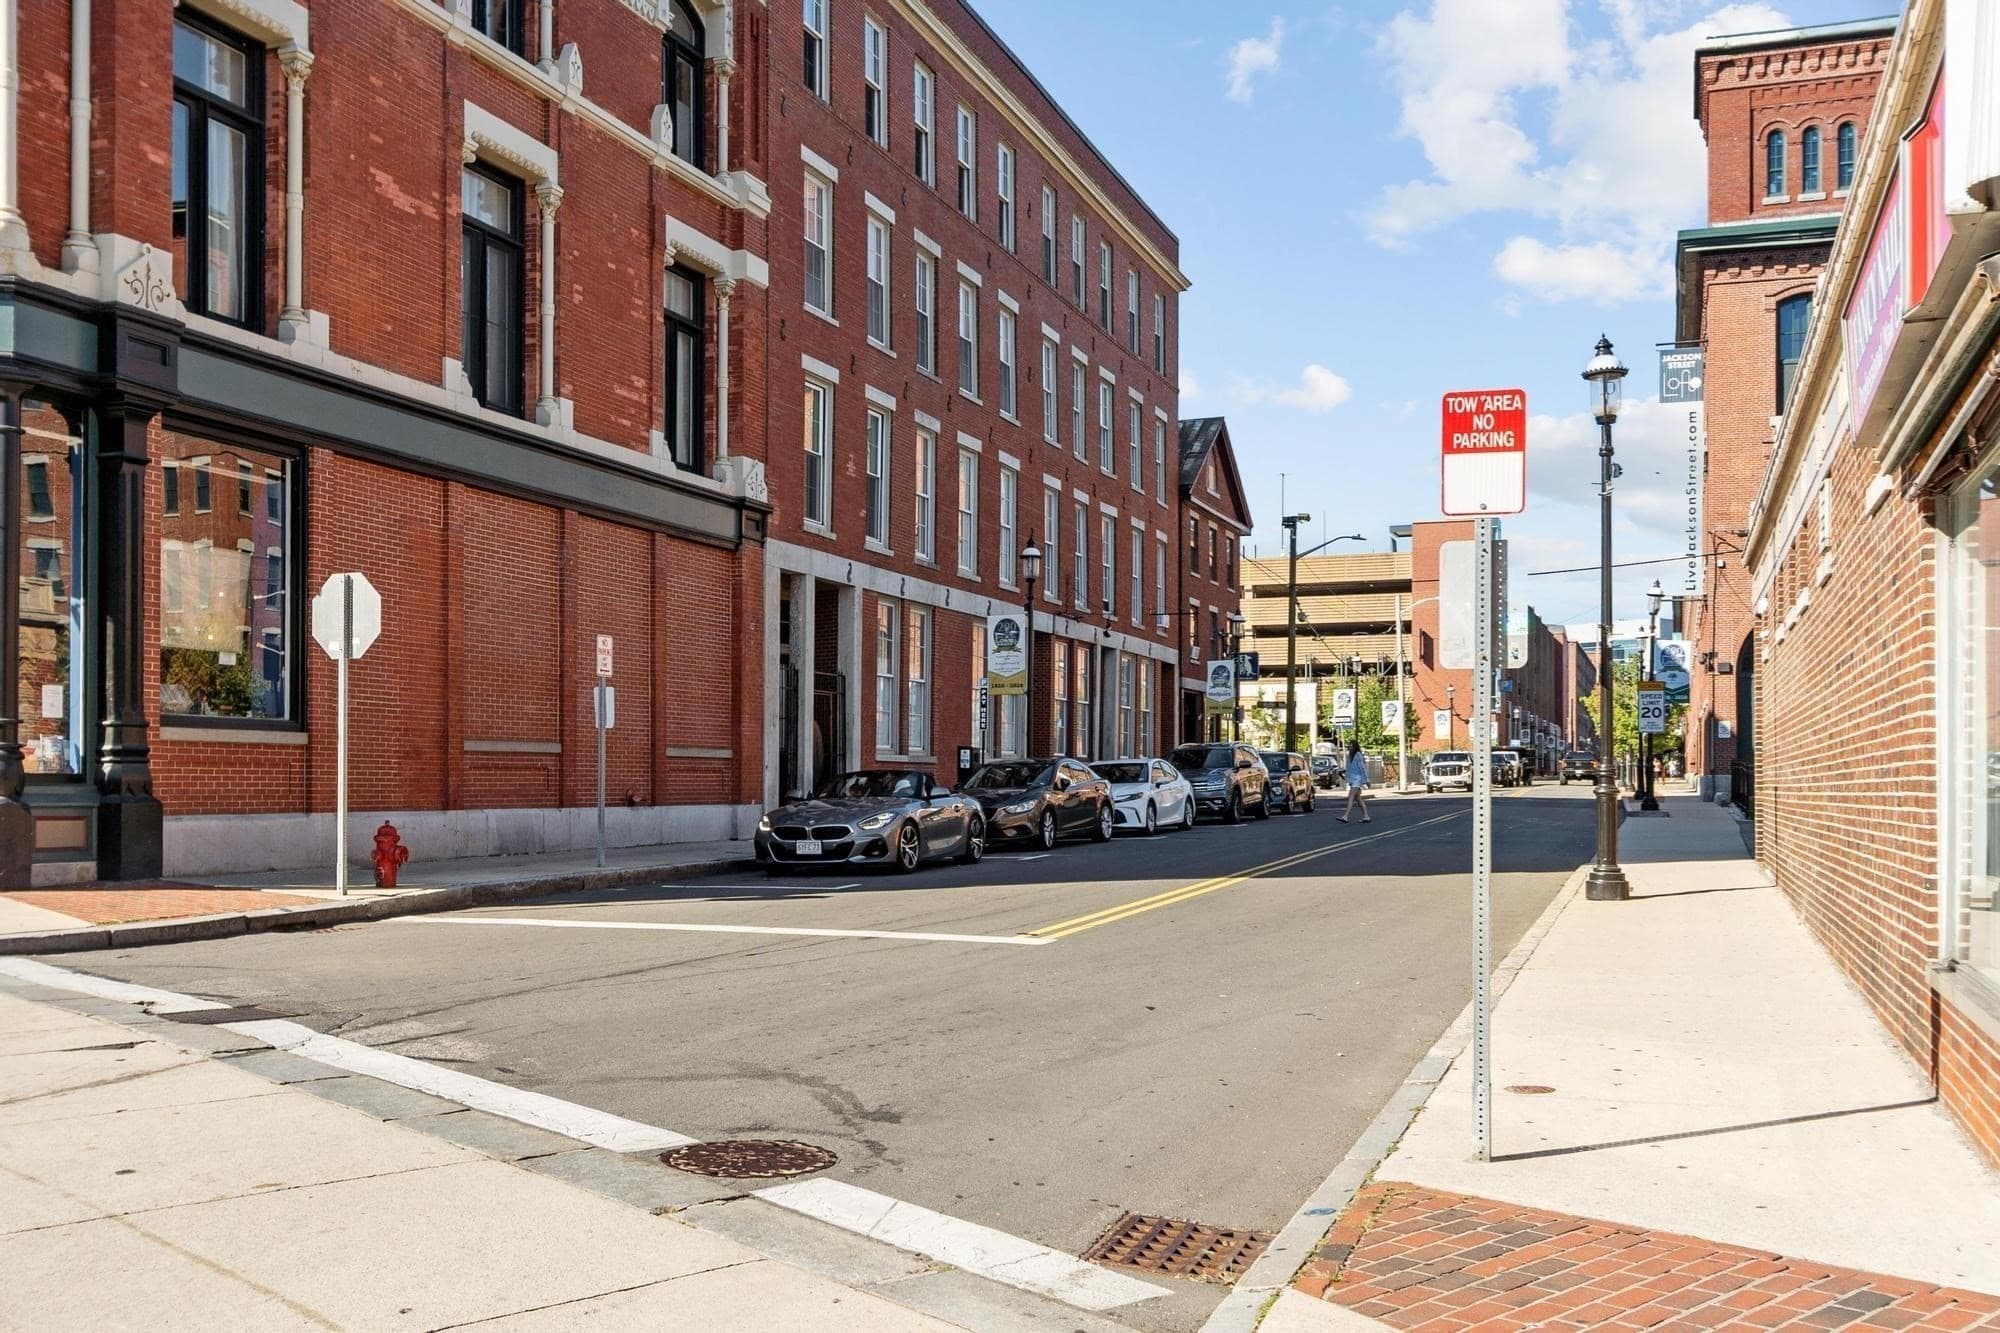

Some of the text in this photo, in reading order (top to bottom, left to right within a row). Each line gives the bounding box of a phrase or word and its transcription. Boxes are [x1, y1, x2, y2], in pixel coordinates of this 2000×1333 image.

[1447, 394, 1523, 413] TOW AREA
[1473, 414, 1494, 430] NO
[1453, 431, 1515, 449] PARKING
[1685, 411, 1697, 591] LiveJacksonStreet.com
[1641, 707, 1662, 718] 20
